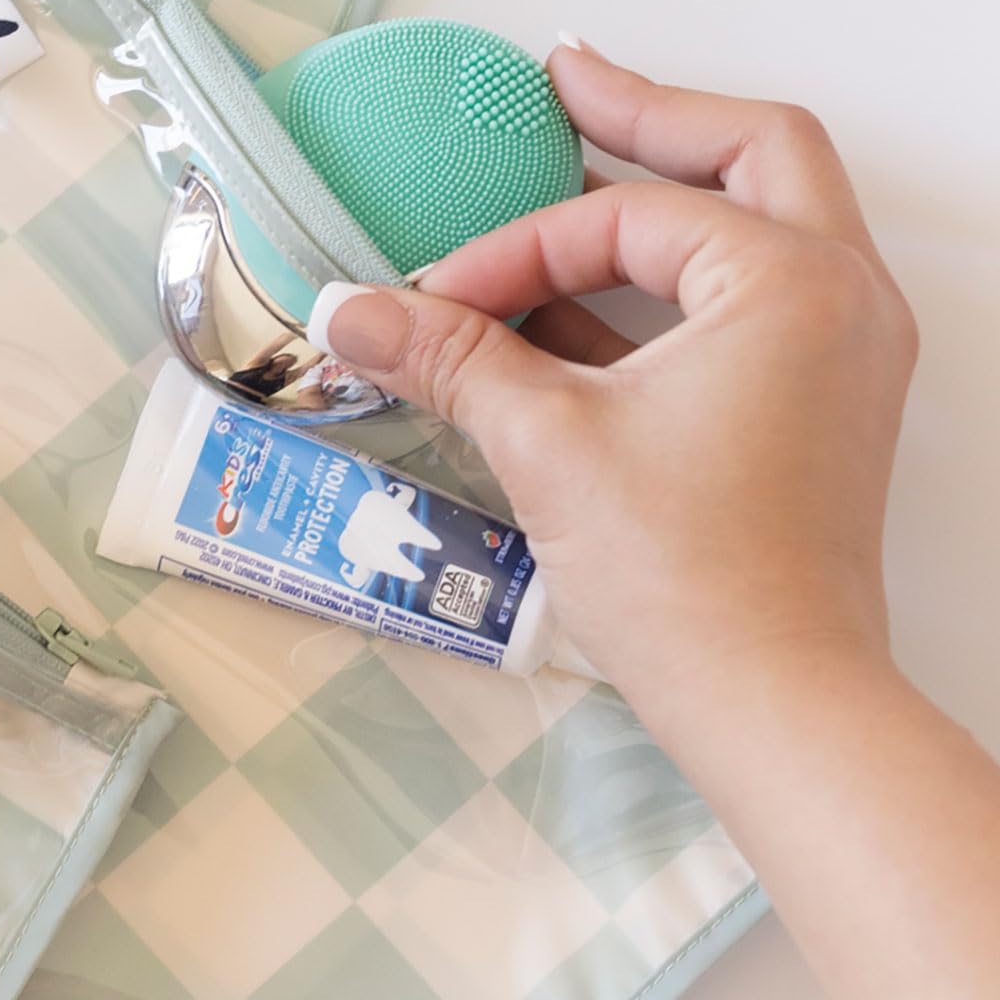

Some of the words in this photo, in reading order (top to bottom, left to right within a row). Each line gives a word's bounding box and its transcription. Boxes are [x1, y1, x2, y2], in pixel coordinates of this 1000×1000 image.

[281, 506, 308, 558] ENAMEL
[305, 451, 328, 497] CAVITY
[293, 454, 351, 566] PROTECTION
[434, 568, 460, 610] ADA
[452, 573, 472, 614] Accepted
[496, 608, 510, 625] NET
